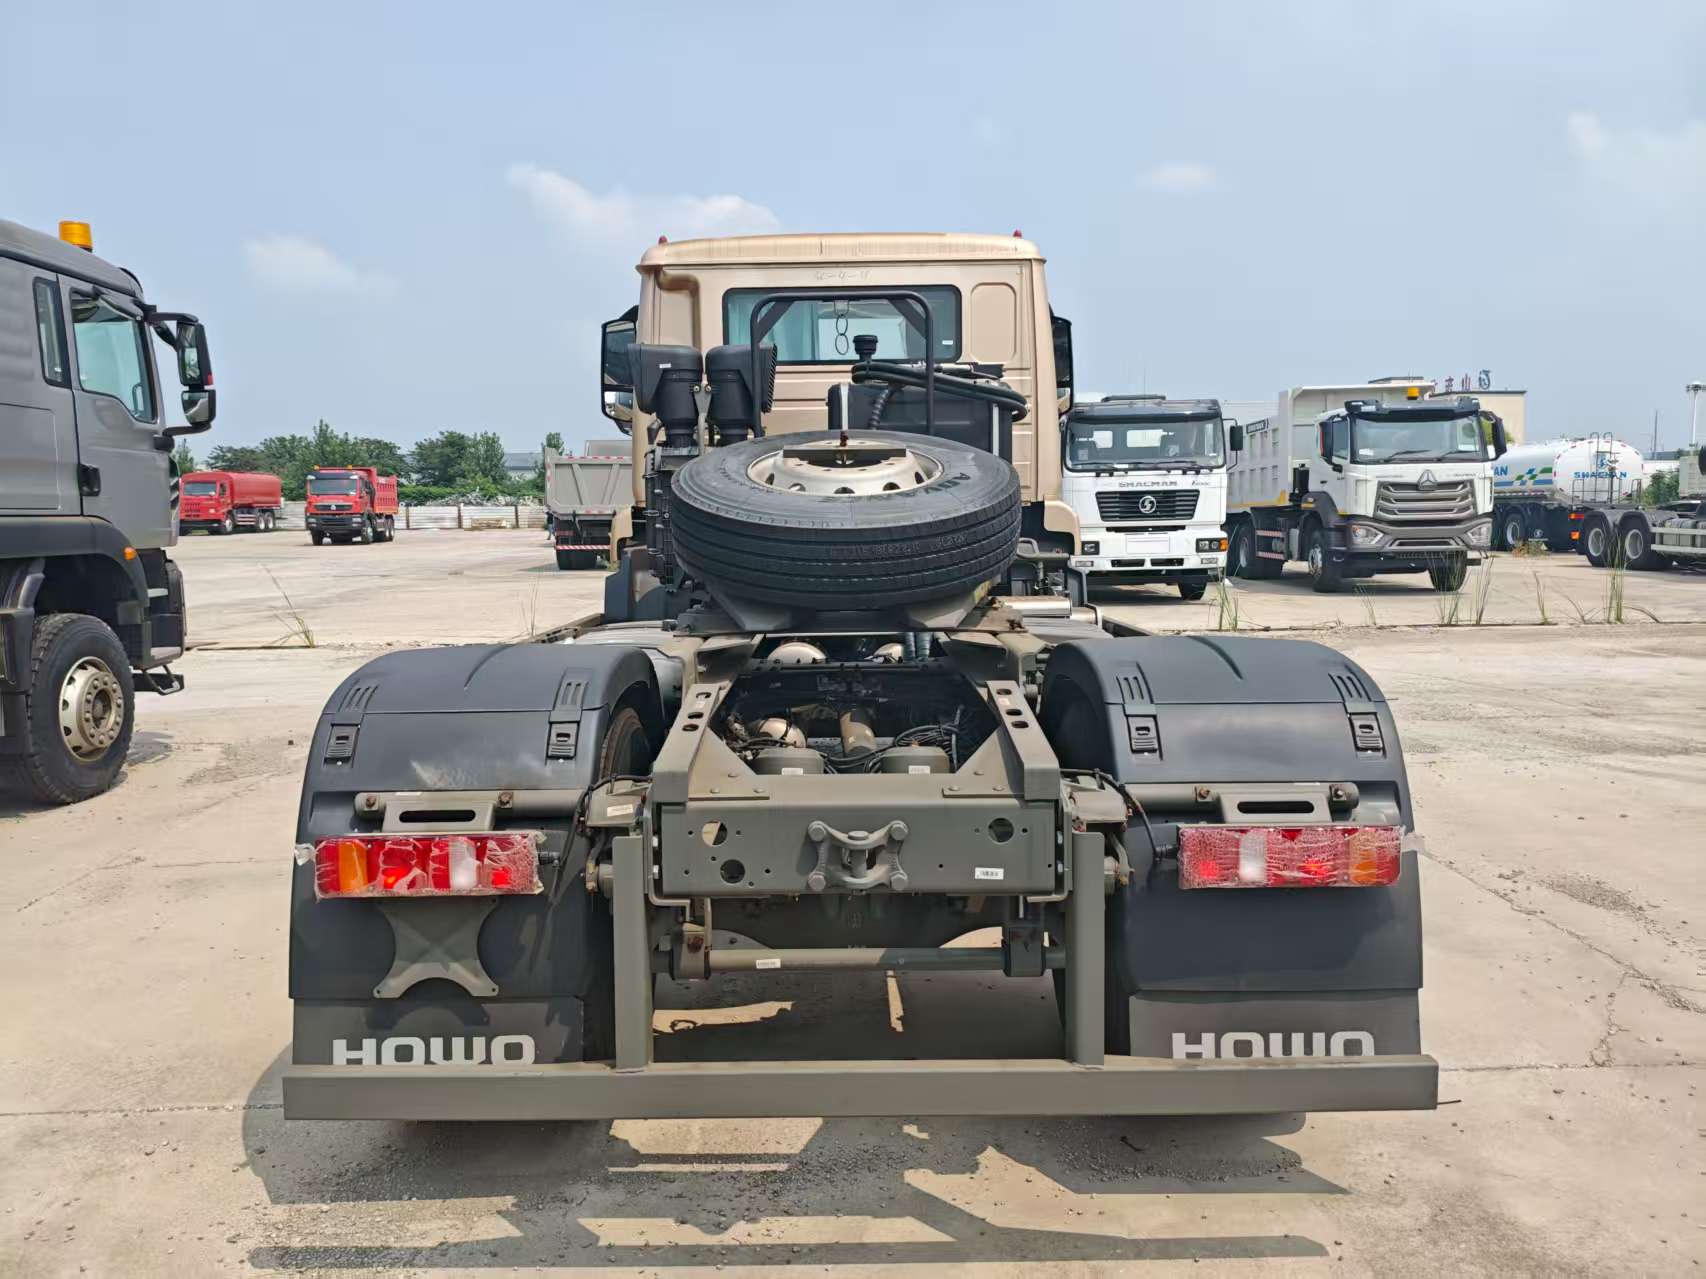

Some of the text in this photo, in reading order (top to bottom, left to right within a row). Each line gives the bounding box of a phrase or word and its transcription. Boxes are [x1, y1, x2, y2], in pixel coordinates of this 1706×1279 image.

[1119, 480, 1177, 488] SHACMAN
[332, 1034, 536, 1066] HOWO
[1172, 1031, 1375, 1059] HOWO
